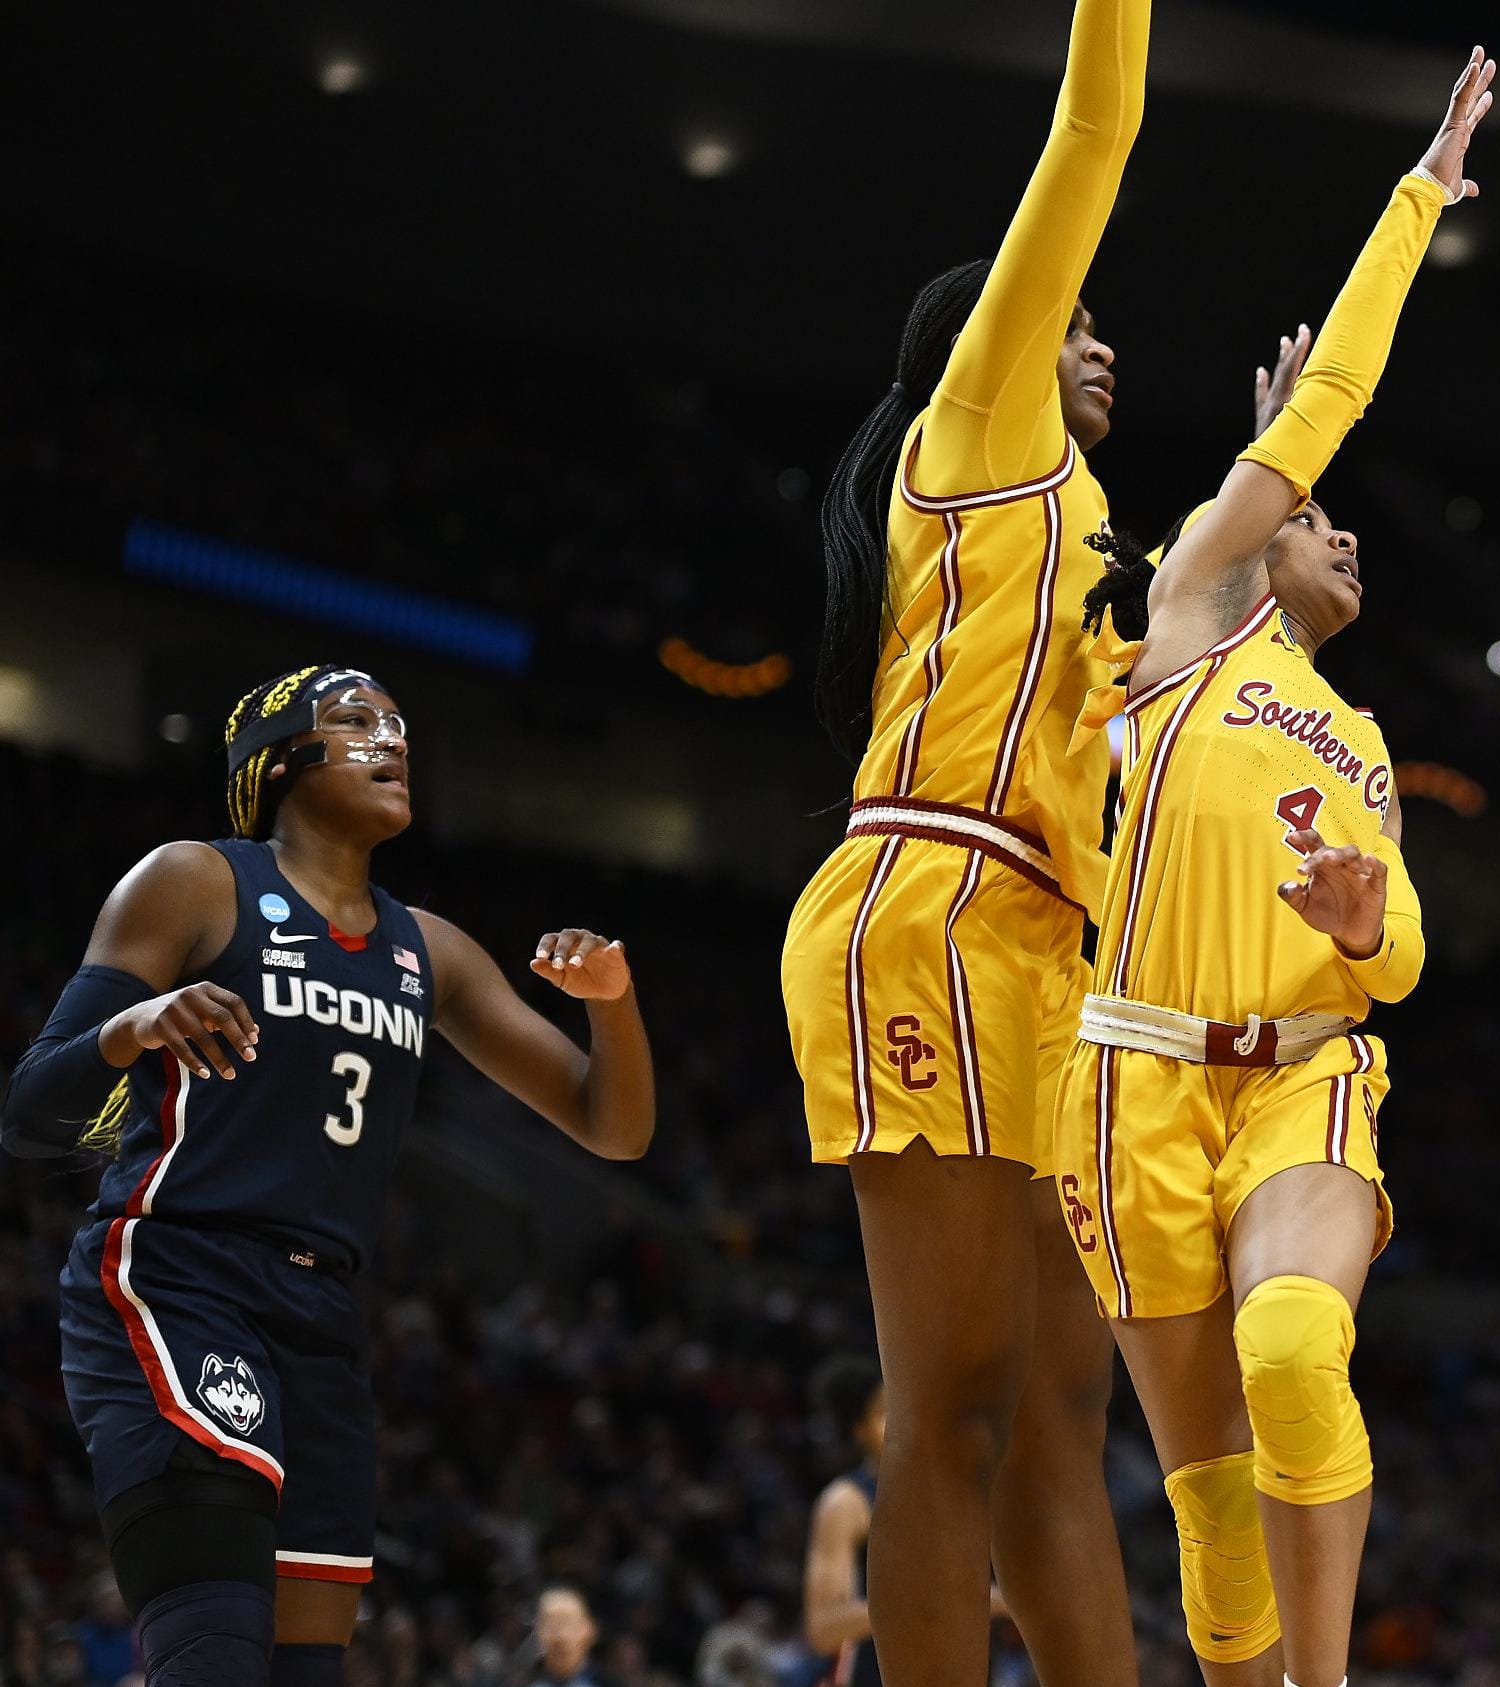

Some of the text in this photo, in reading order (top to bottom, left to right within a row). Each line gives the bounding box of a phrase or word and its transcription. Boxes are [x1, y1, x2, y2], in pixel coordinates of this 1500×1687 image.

[1222, 681, 1363, 784] Southern
[1274, 784, 1325, 858] 4
[262, 972, 424, 1059] UCONN
[886, 1013, 938, 1092] SC
[323, 1051, 372, 1146] 3
[1061, 1173, 1099, 1253] SC
